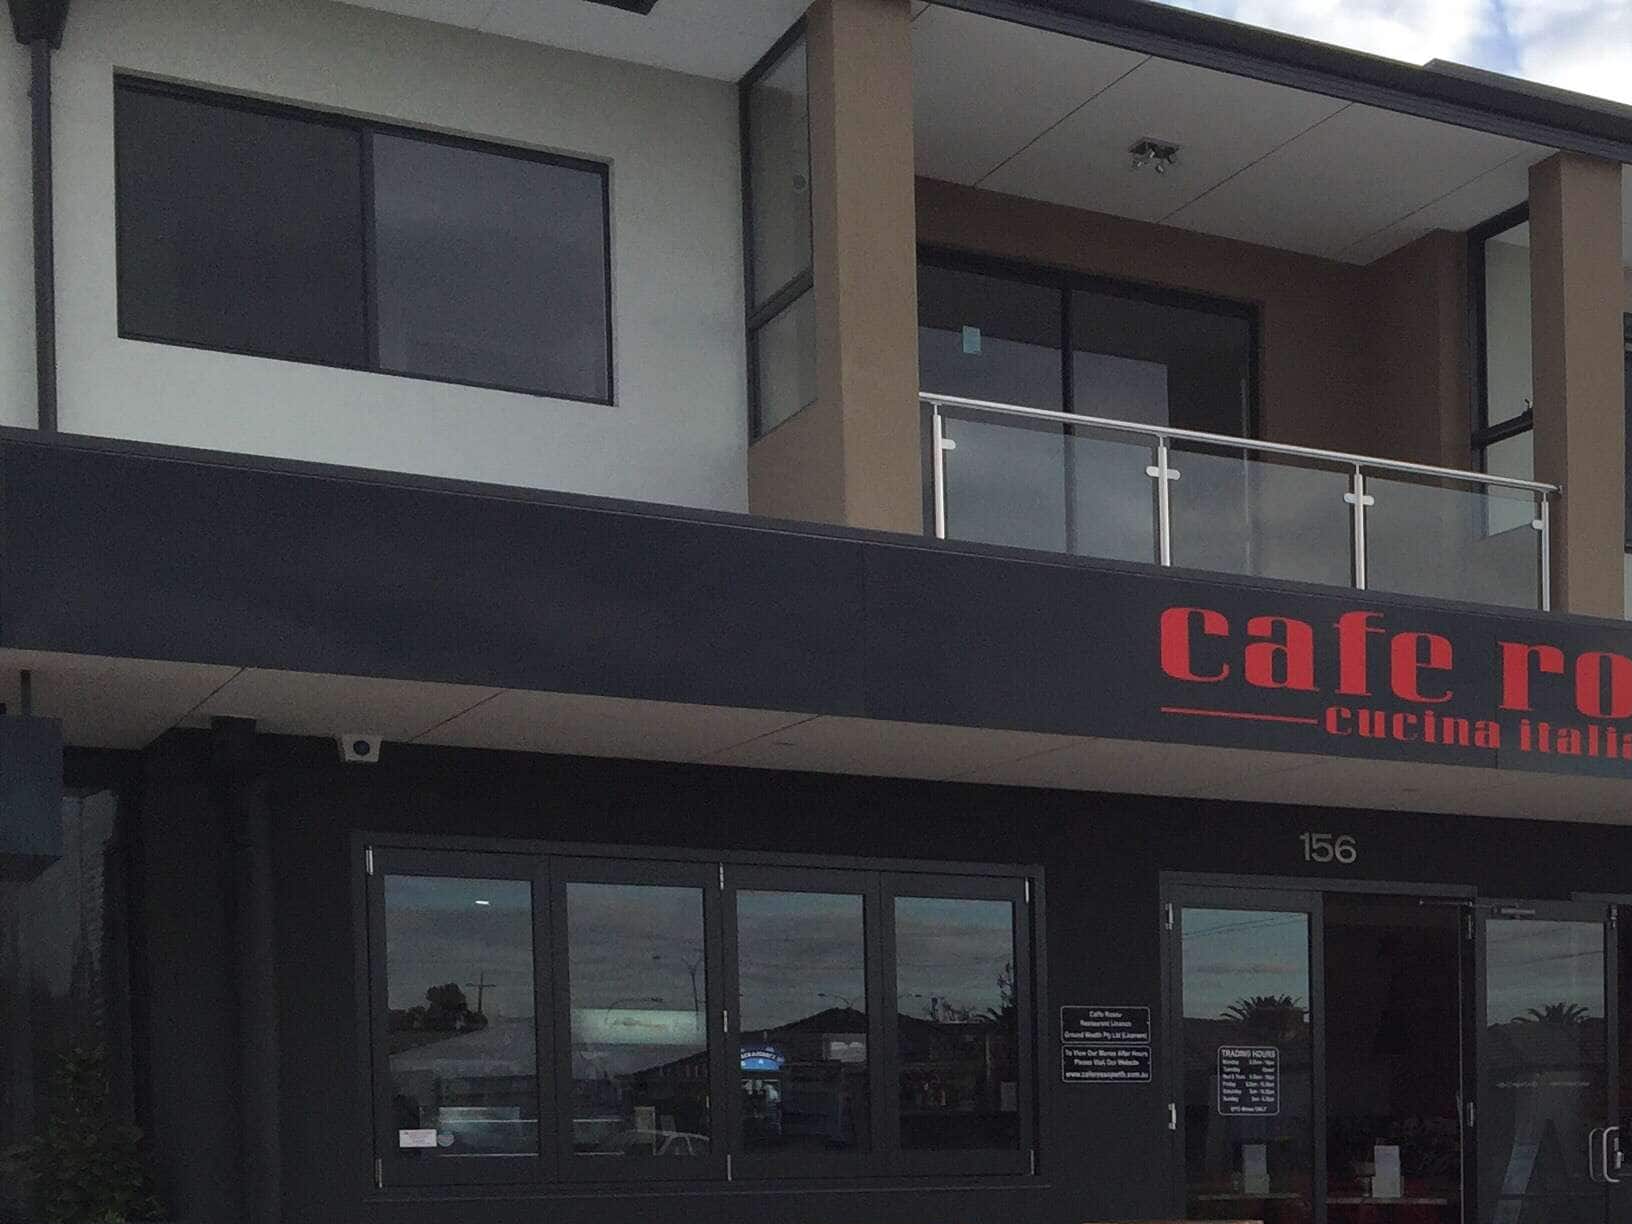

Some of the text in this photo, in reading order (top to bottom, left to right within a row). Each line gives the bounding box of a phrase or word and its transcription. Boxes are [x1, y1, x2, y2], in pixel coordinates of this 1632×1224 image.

[1160, 606, 1455, 702] cafe
[1325, 705, 1500, 749] cucina
[1299, 832, 1357, 864] 156
[1252, 1050, 1276, 1058] HOURS
